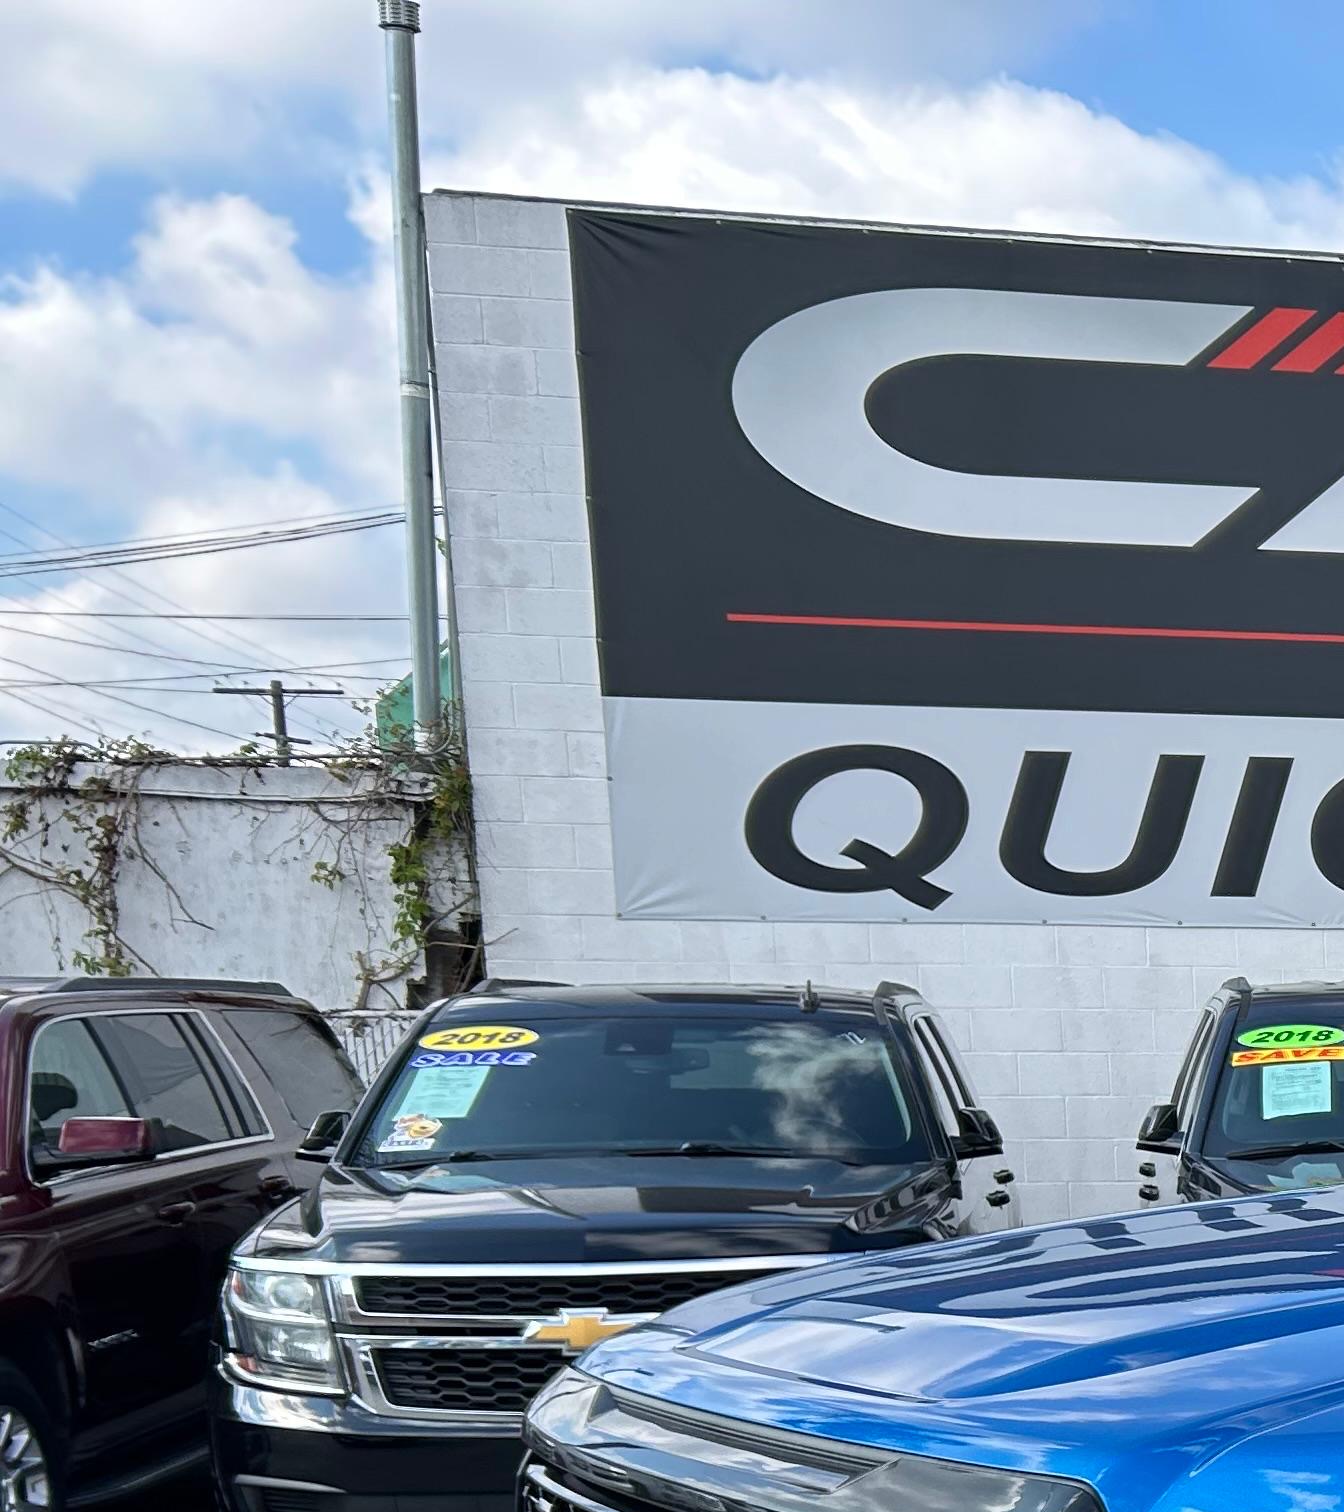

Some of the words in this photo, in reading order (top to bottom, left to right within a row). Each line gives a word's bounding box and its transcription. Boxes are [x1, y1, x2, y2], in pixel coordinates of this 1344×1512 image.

[433, 1032, 526, 1045] 2018
[1251, 1030, 1335, 1044] 2018
[1235, 1049, 1342, 1062] SAVE
